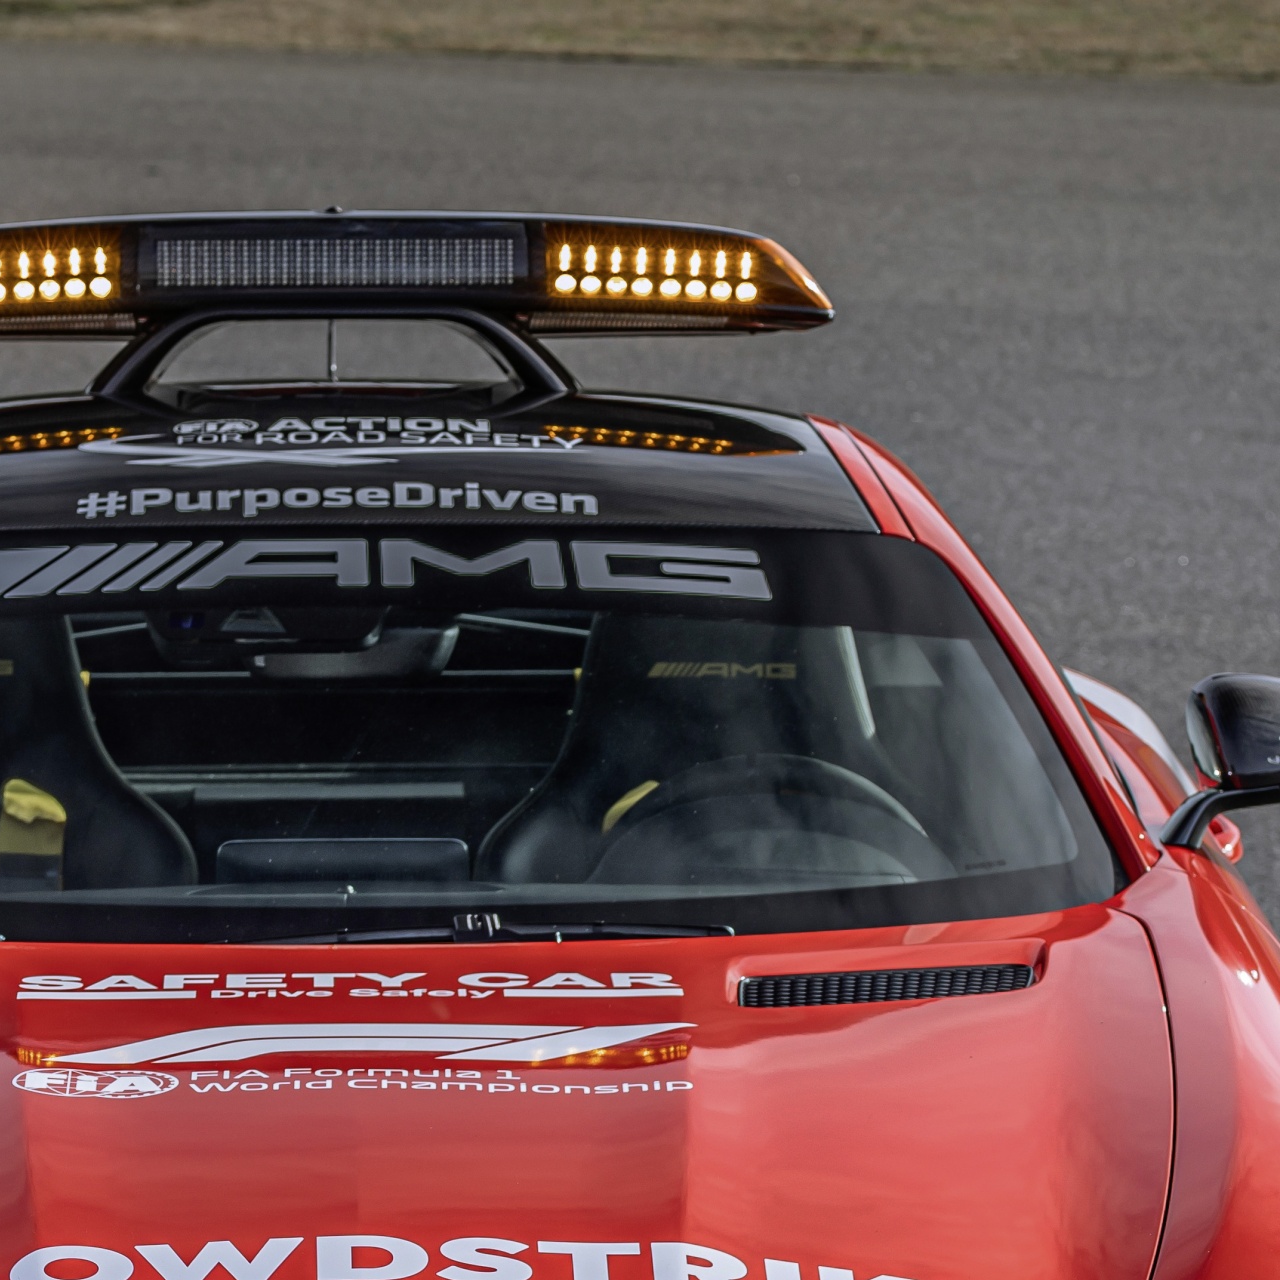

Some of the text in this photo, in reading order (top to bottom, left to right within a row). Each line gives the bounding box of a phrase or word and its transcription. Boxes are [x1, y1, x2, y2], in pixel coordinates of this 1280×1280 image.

[267, 417, 490, 432] ACTION
[176, 431, 583, 449] FOR ROAD SAFETY
[77, 482, 599, 519] #PurposeDriven
[19, 972, 681, 990] SAFETY CAR
[210, 988, 496, 999] Drive Safely
[190, 1067, 521, 1081] FIA Formula 1
[188, 1078, 694, 1095] World Championship
